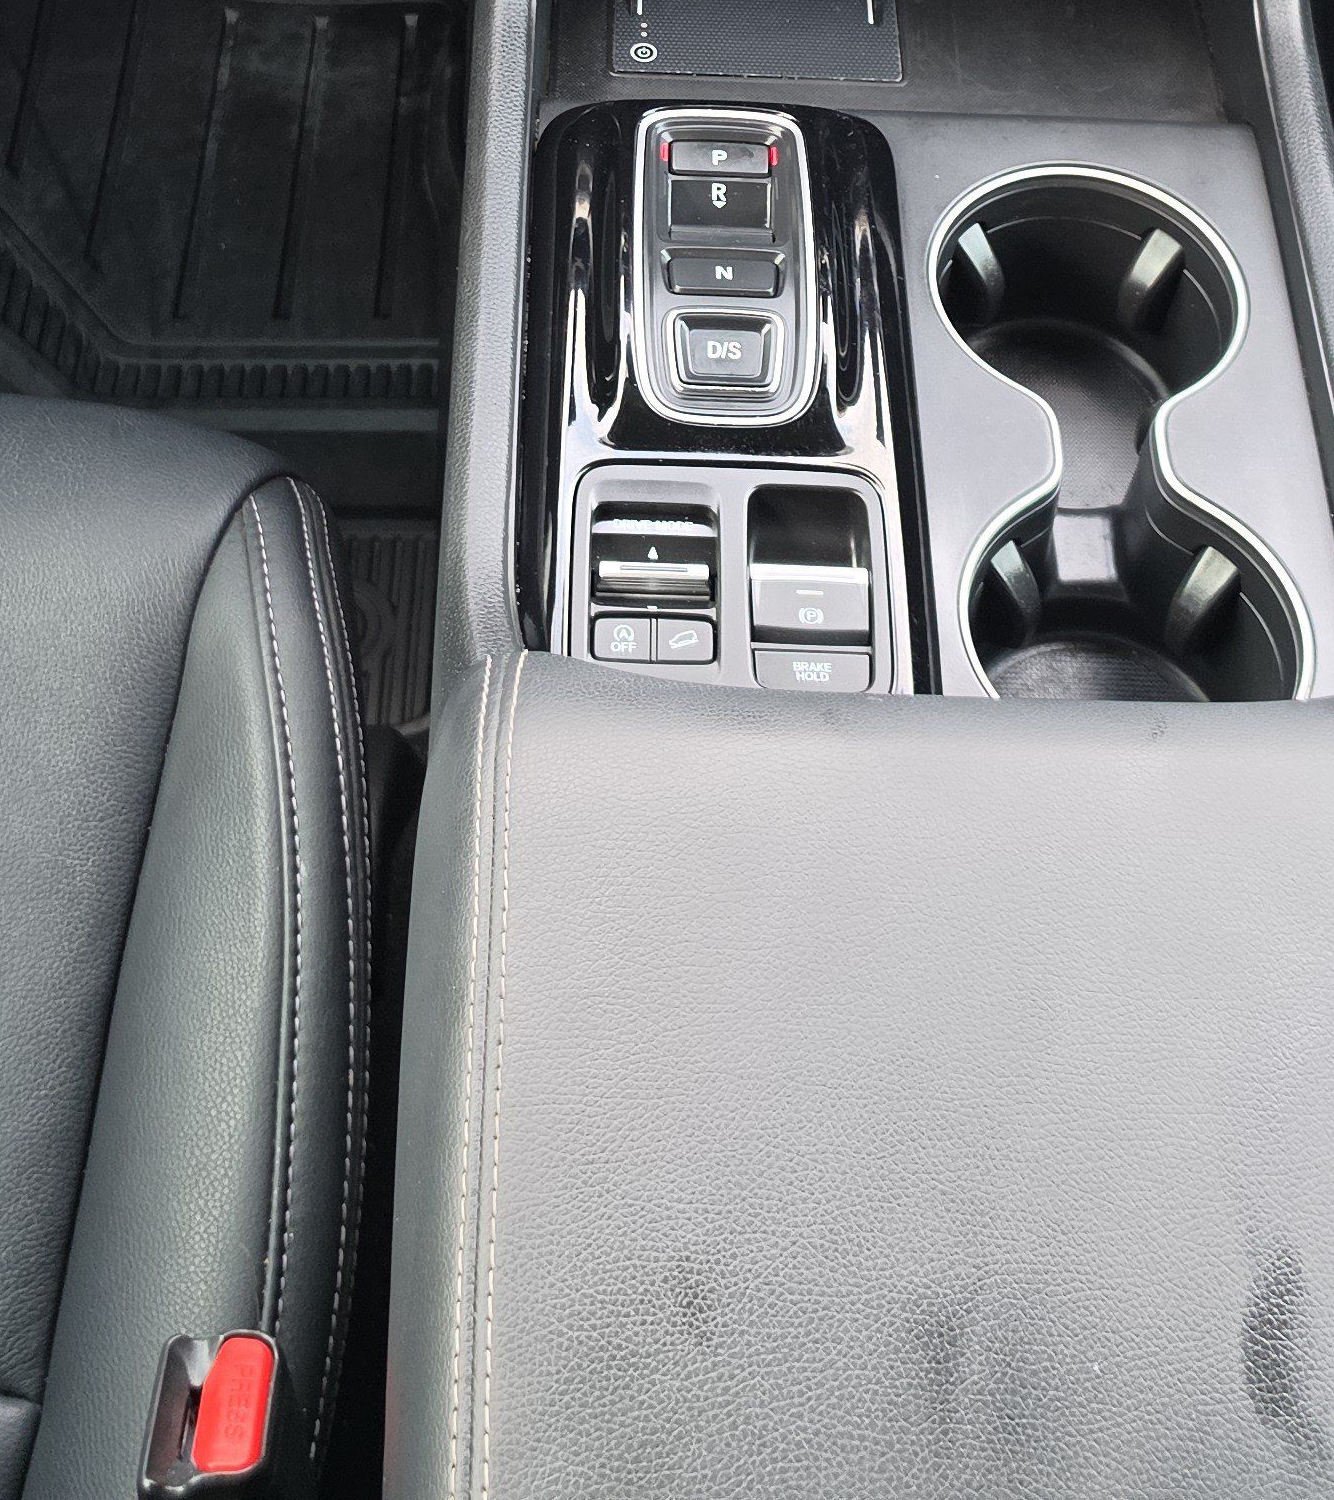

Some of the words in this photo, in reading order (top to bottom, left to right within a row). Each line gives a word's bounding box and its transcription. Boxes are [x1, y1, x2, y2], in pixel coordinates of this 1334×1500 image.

[711, 150, 728, 166] P
[711, 182, 727, 201] R
[715, 266, 734, 280] N
[706, 341, 742, 360] D/S
[611, 641, 637, 652] OFF
[792, 661, 832, 673] BRAKE
[796, 670, 830, 682] HOLD
